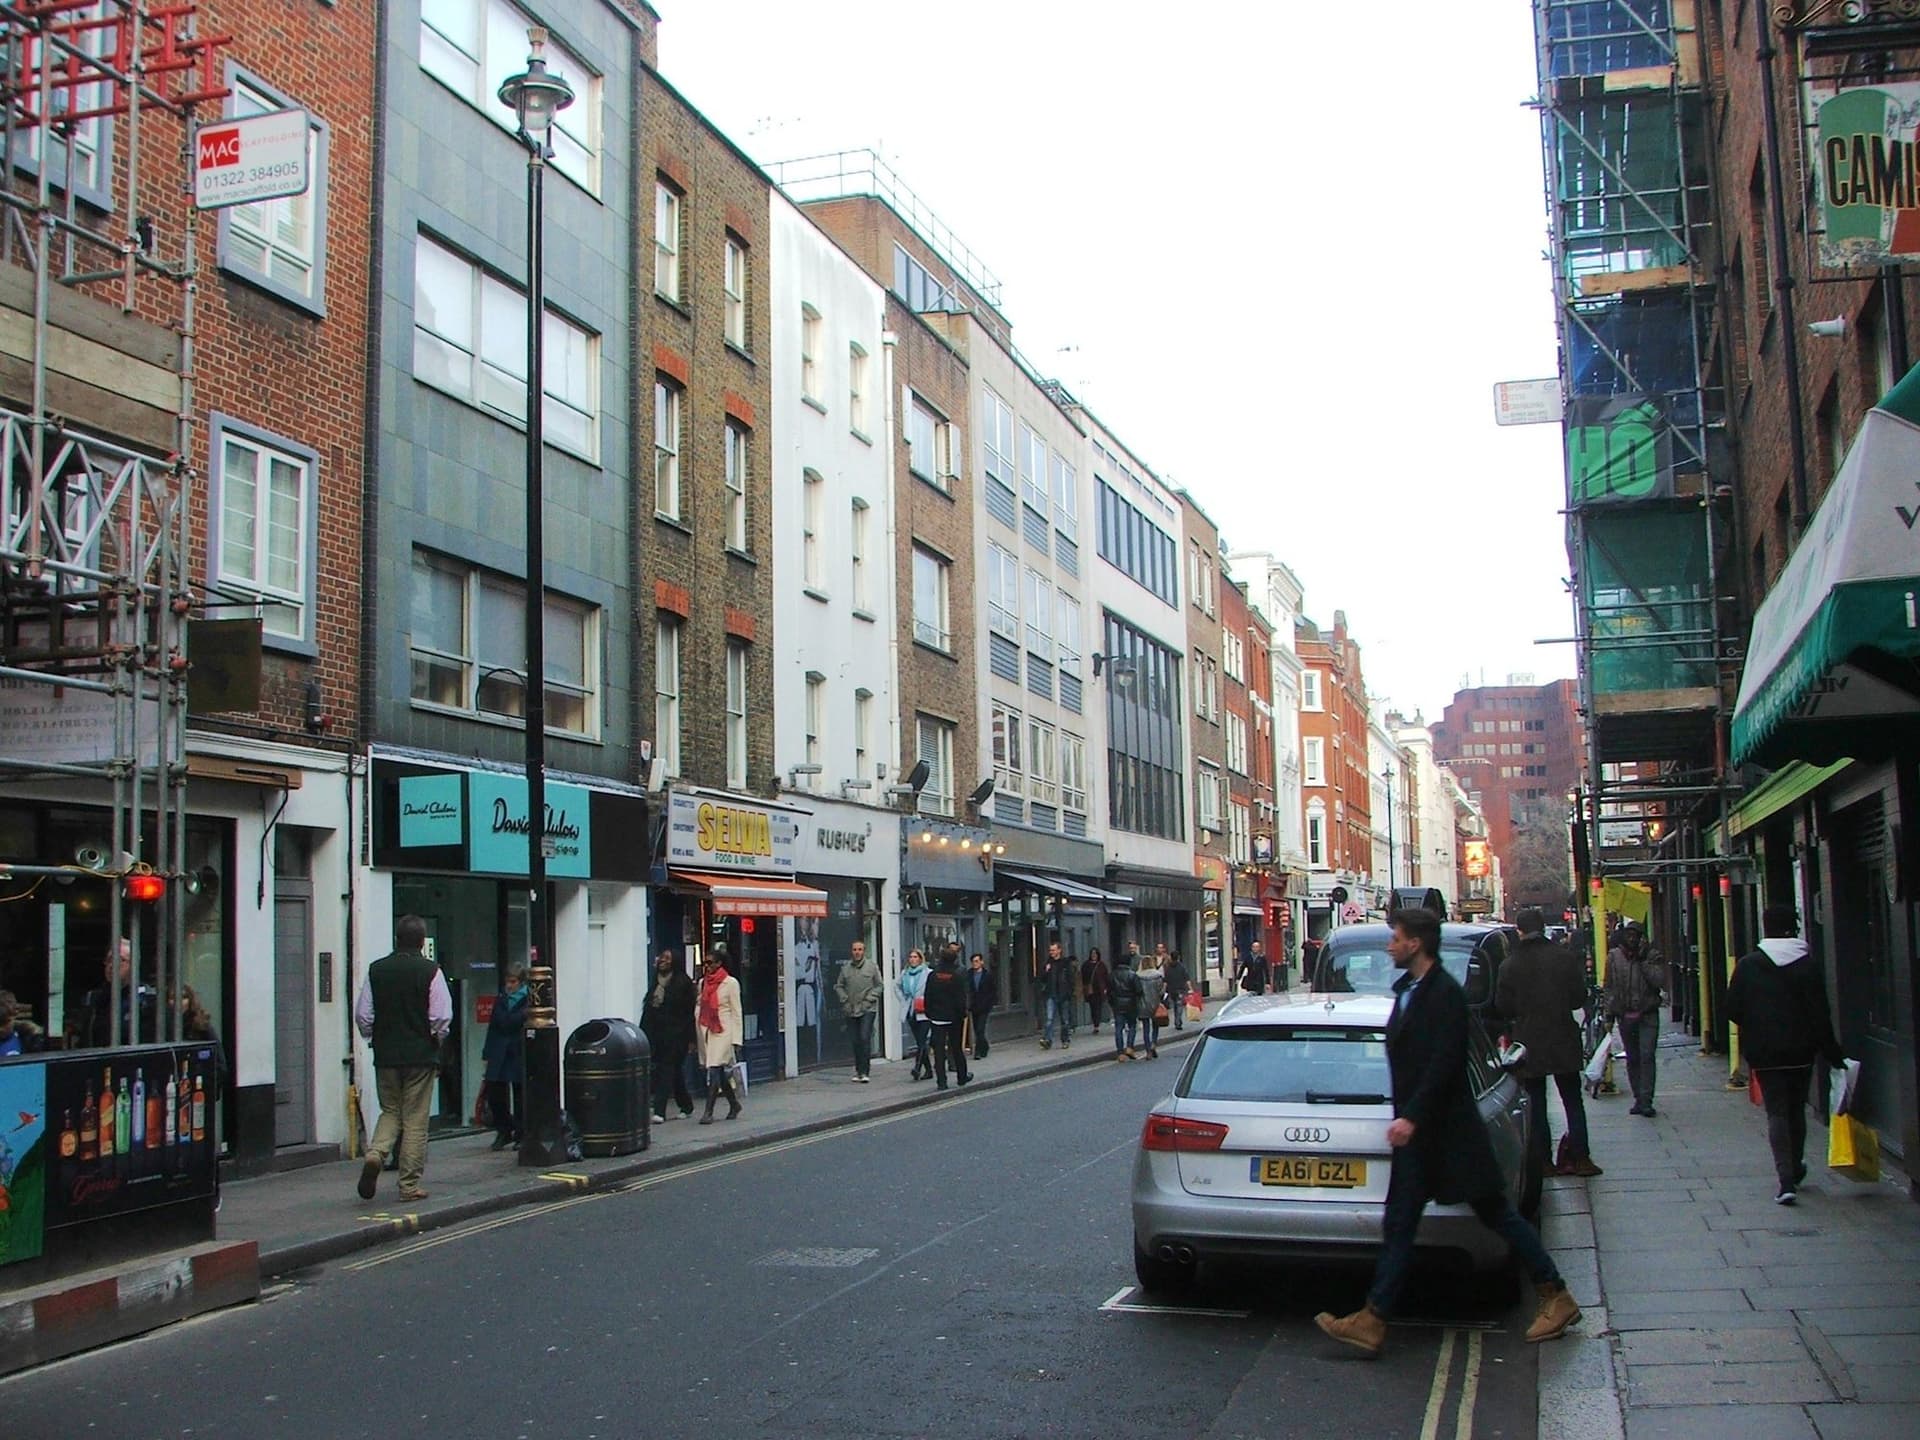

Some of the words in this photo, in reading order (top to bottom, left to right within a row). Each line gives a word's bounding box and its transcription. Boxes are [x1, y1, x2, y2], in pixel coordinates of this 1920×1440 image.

[200, 137, 239, 167] MAC
[203, 170, 245, 190] 01322
[249, 161, 299, 182] 384905
[1826, 134, 1920, 208] CAMI
[403, 803, 428, 815] David
[429, 801, 456, 814] Clulow
[697, 802, 772, 857] SELVA
[817, 827, 866, 853] RUSHES
[715, 852, 731, 863] FOOD
[741, 856, 756, 866] WINE
[1318, 1162, 1357, 1182] GZL
